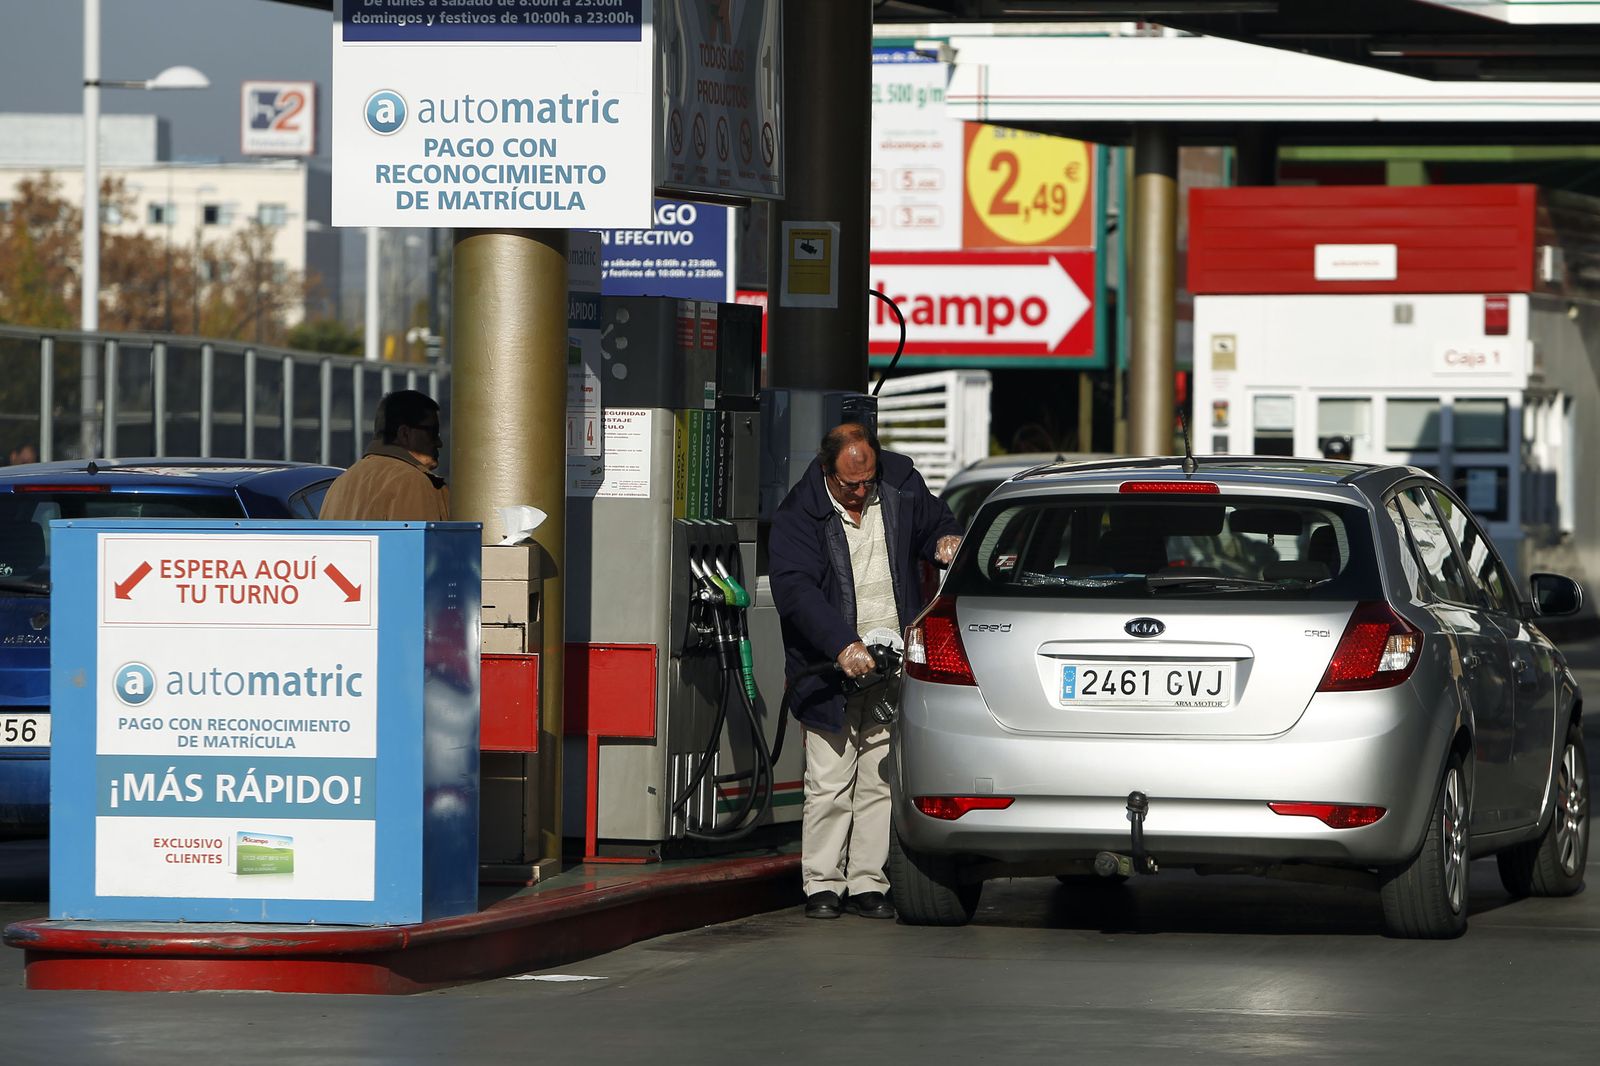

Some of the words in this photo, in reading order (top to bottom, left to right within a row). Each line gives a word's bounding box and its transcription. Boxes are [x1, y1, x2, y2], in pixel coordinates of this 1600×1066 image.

[351, 12, 422, 26] domingos
[426, 14, 436, 26] y
[440, 12, 496, 24] festivos
[500, 12, 518, 24] de
[523, 12, 570, 24] 10:00h
[574, 14, 582, 24] a
[586, 12, 634, 24] 23:00h
[699, 43, 727, 69] TODOS
[728, 47, 745, 73] LOS
[697, 79, 748, 109] PRODUCTOS
[375, 99, 396, 124] a
[418, 90, 620, 124] automatric
[424, 138, 494, 158] PAGO
[502, 138, 557, 158] CON
[376, 164, 606, 184] RECONOCIMIENTO
[396, 190, 428, 210] DE
[438, 186, 586, 210] MATRÍCULA
[615, 230, 694, 246] EFECTIVO
[609, 269, 643, 278] festivos
[568, 296, 597, 320] ÁPIDO!
[876, 280, 1048, 335] lcampo
[1444, 349, 1486, 368] Caja
[1492, 349, 1501, 365] 1
[586, 420, 594, 446] 4
[160, 558, 247, 580] ESPERA
[254, 556, 316, 582] AQUÍ
[176, 584, 208, 604] TU
[215, 584, 299, 604] TURNO
[1130, 623, 1159, 633] KIA
[124, 670, 144, 696] a
[166, 664, 362, 698] automatric
[1082, 670, 1150, 696] 2461
[1166, 670, 1222, 696] GVJ
[0, 719, 37, 742] 56
[118, 718, 164, 731] PAGO
[168, 718, 202, 731] CON
[208, 718, 350, 733] RECONOCIMIENTO
[178, 735, 198, 748] DE
[204, 732, 296, 749] MATRÍCULA
[110, 766, 203, 808] ¡MÁS
[216, 768, 362, 805] RÁPIDO!
[154, 838, 223, 849] EXCLUSIVO
[165, 854, 222, 864] CLIENTES
